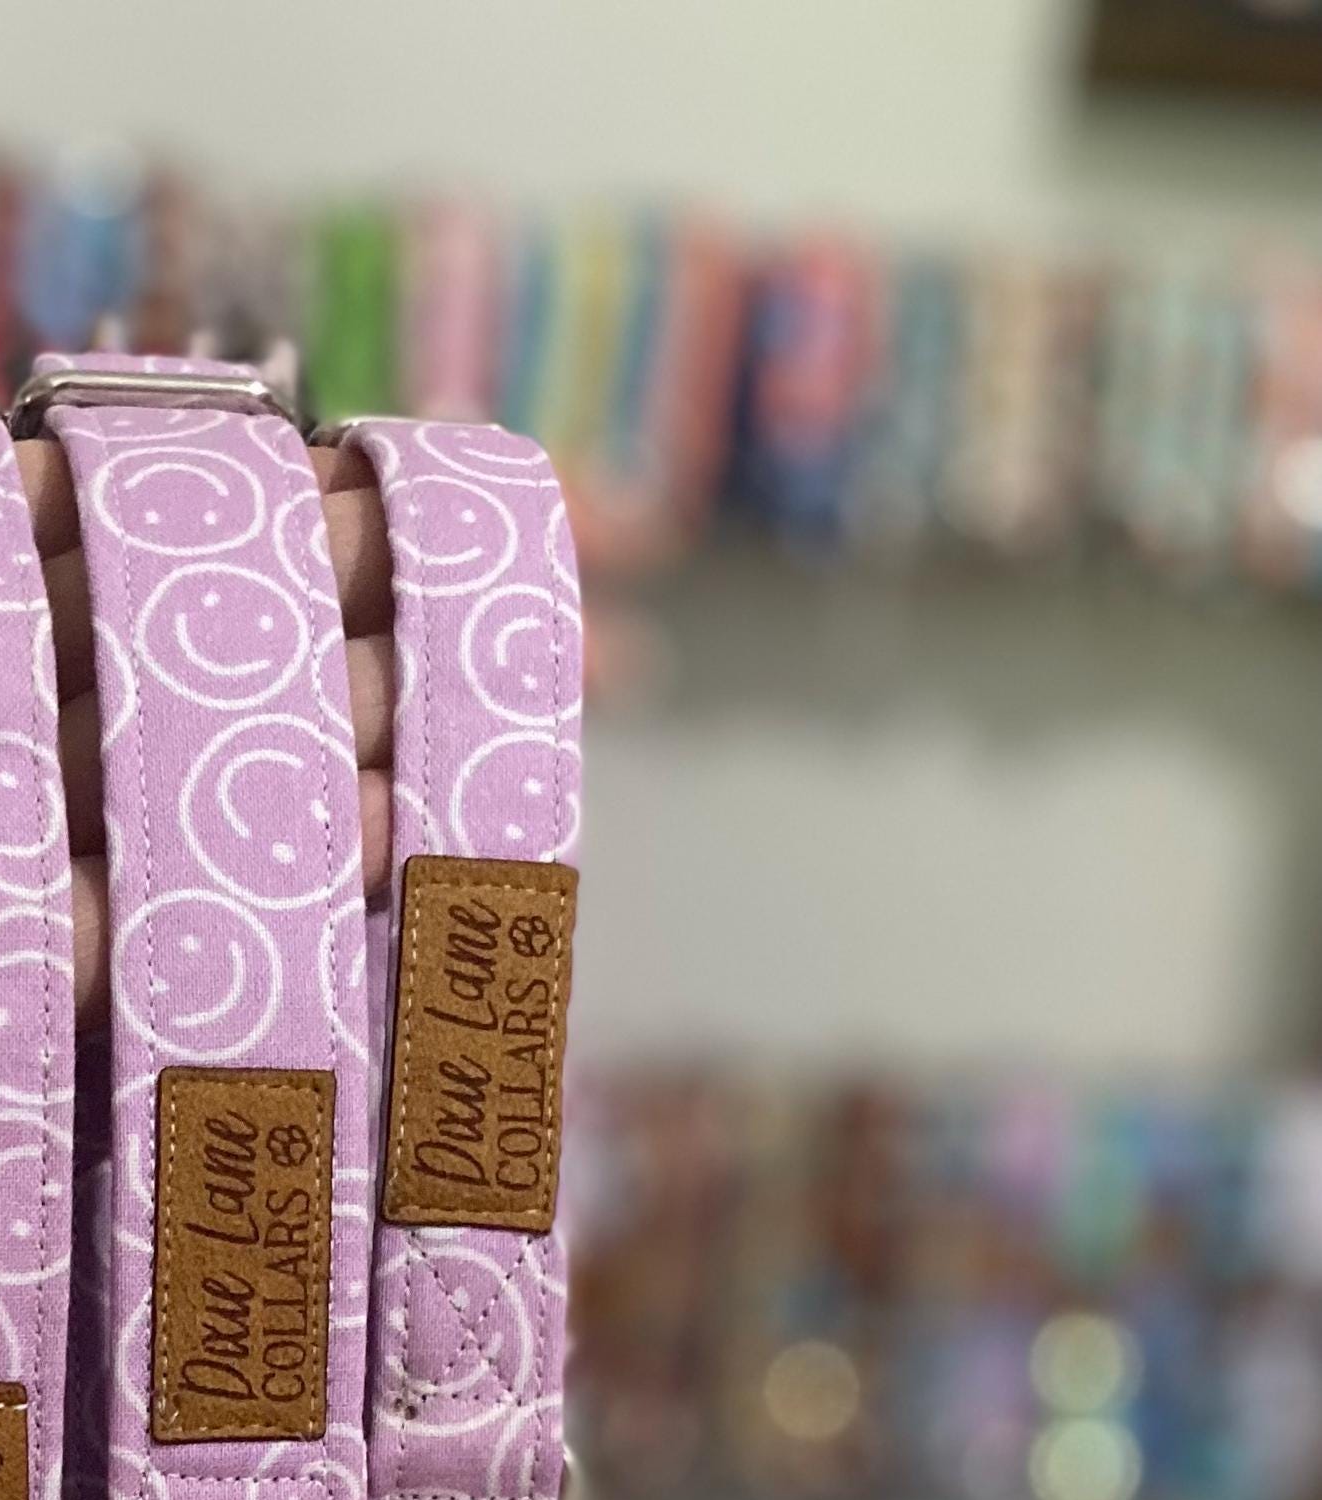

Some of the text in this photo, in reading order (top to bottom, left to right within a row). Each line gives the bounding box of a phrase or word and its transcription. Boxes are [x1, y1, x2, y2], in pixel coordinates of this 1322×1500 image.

[411, 899, 502, 1187] Dixie Lane
[495, 979, 550, 1191] COLLARS
[177, 1109, 259, 1401] Dixie Lane
[261, 1188, 311, 1403] COLLARS
